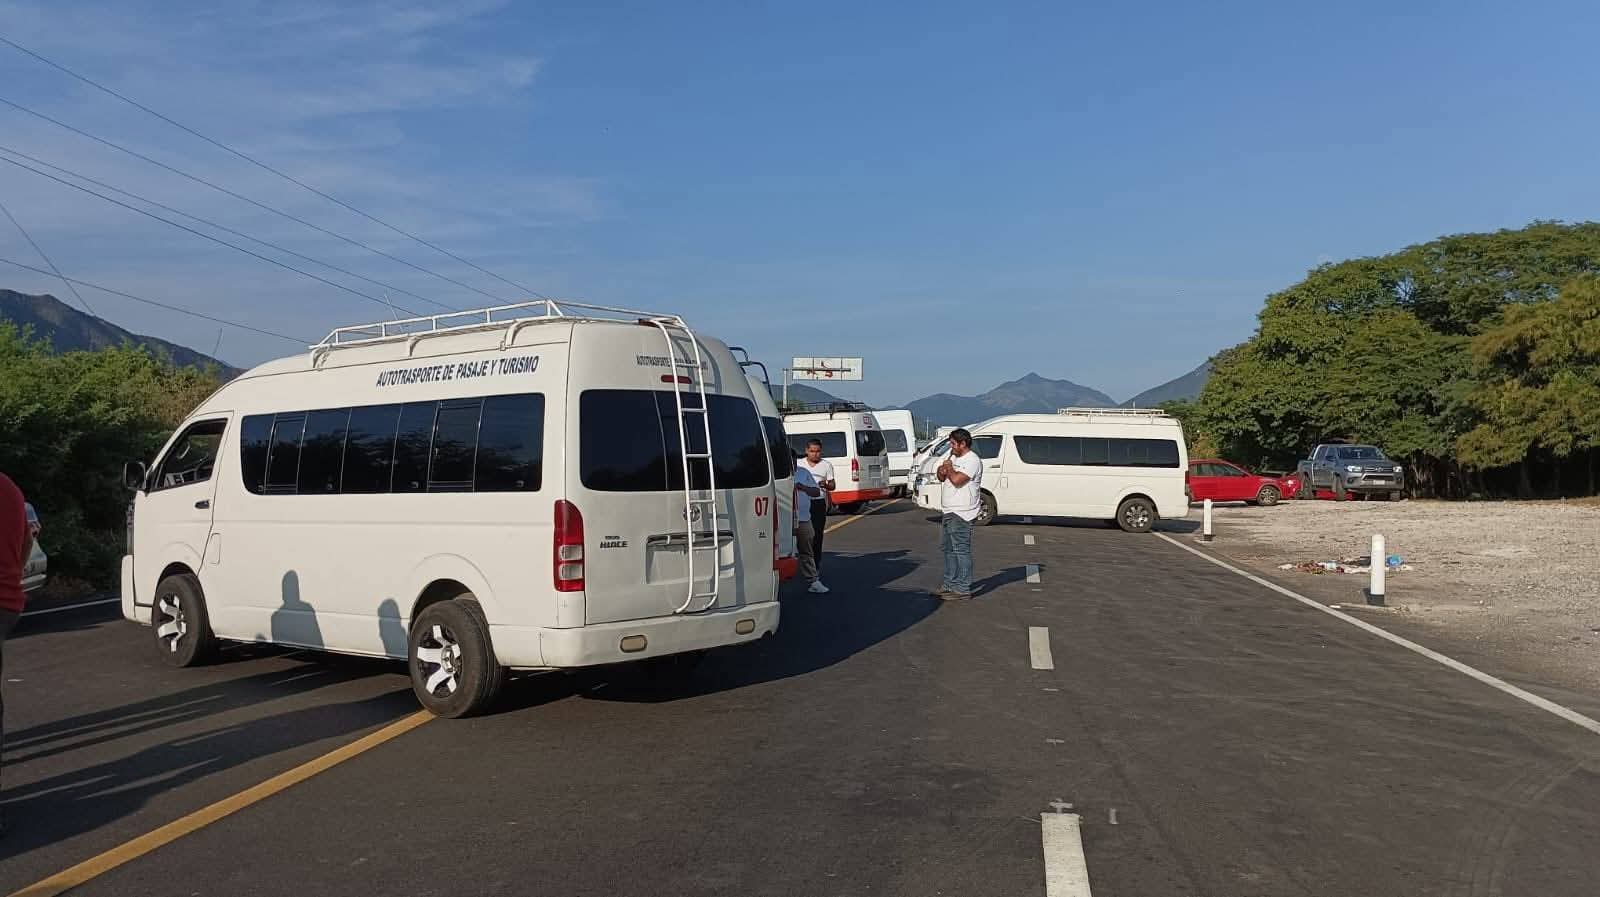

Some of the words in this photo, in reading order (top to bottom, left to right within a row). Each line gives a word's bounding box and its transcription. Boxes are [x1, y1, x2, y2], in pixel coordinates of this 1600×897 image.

[376, 365, 442, 387] AUTOTRASPORTE
[442, 364, 455, 380] DE
[456, 360, 490, 379] PASAJE
[490, 359, 499, 376] Y
[499, 355, 540, 376] TURISMO
[755, 496, 769, 516] 07
